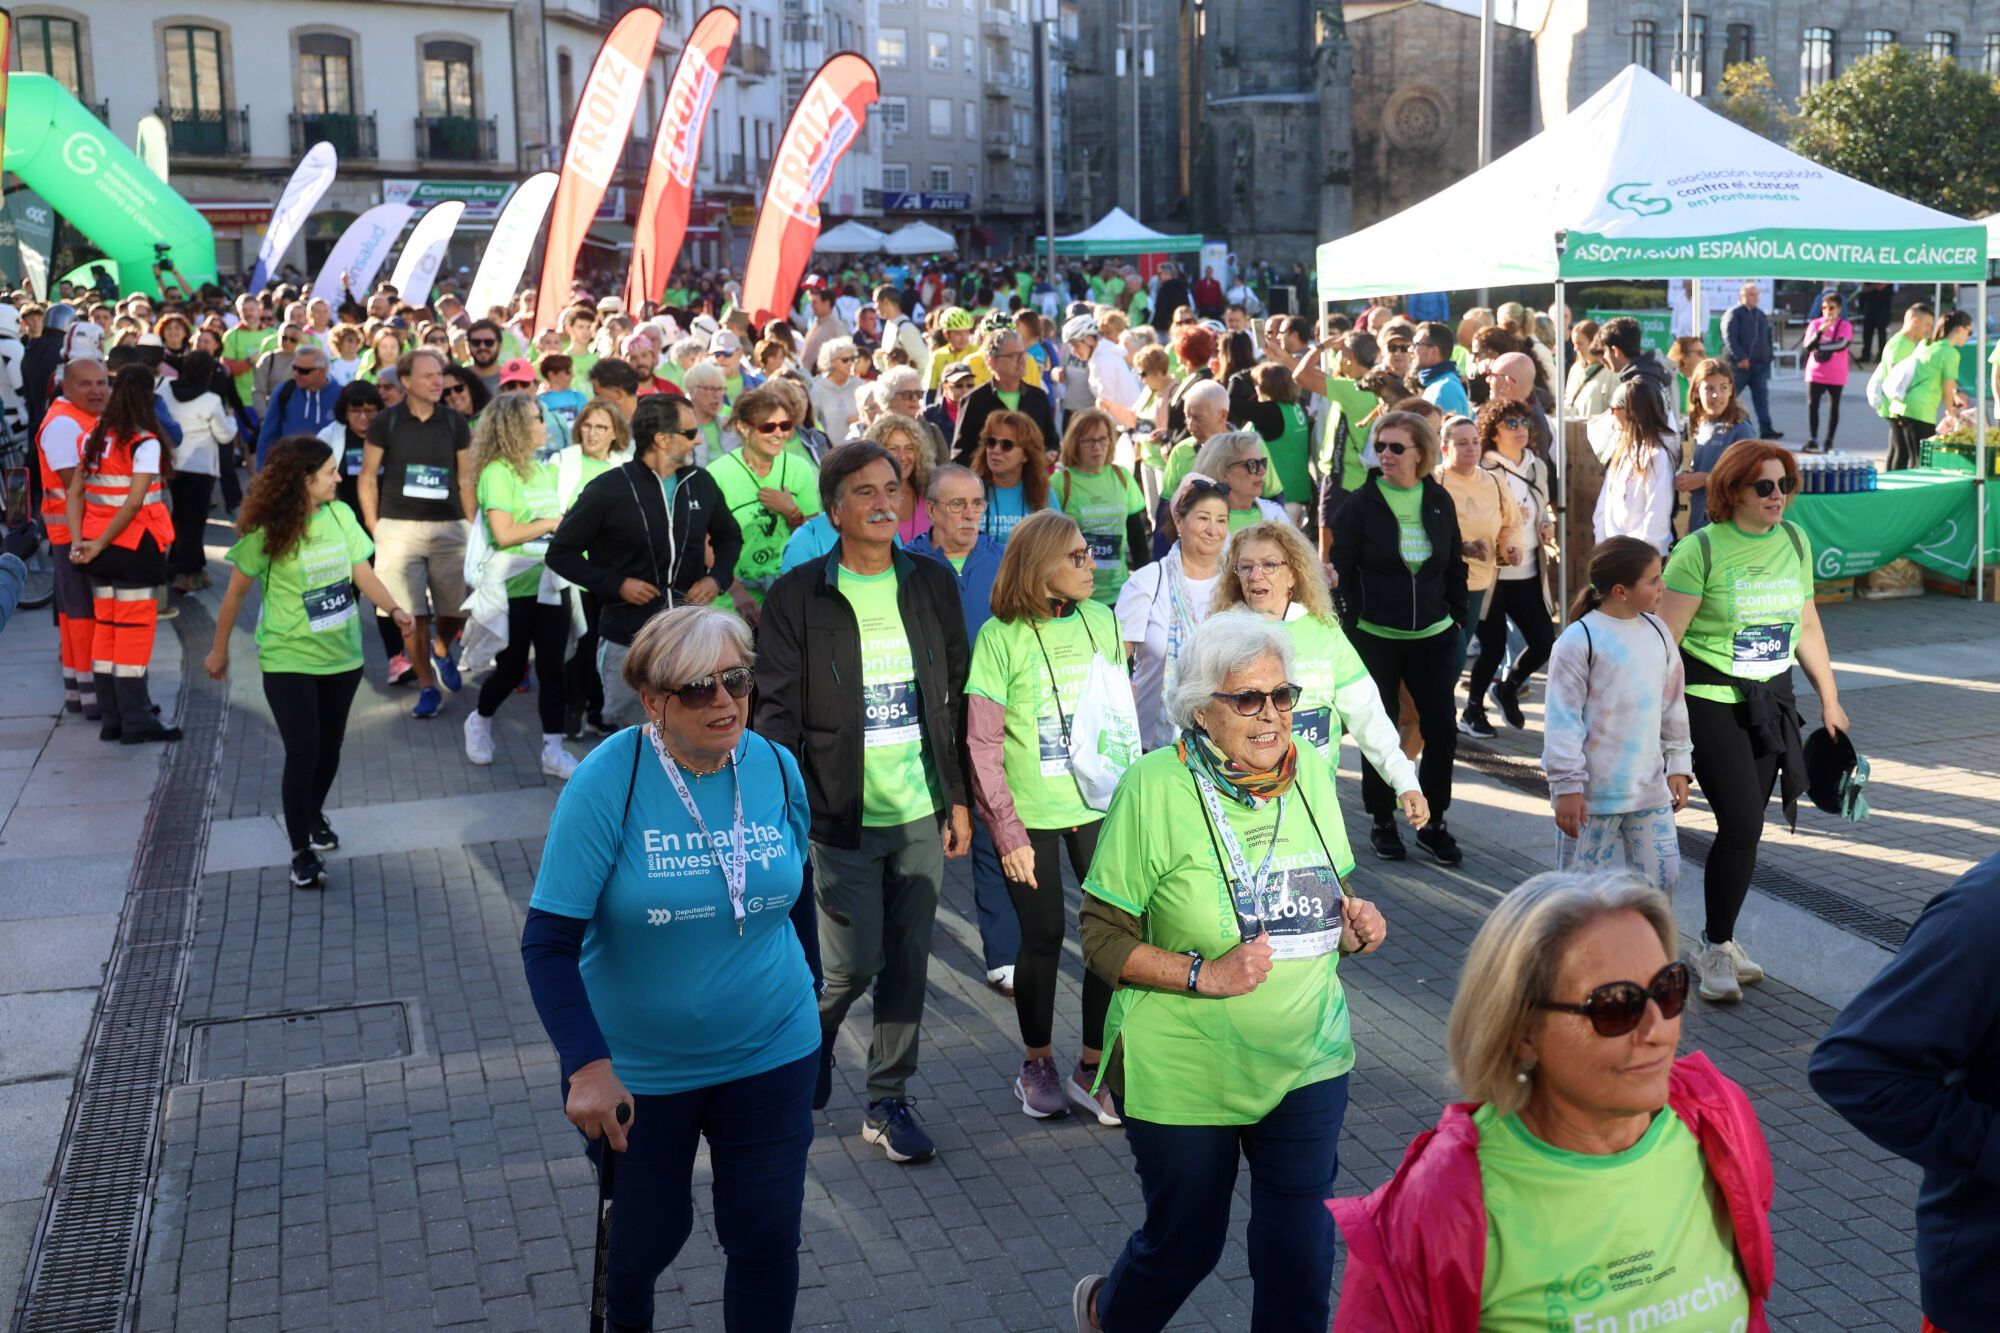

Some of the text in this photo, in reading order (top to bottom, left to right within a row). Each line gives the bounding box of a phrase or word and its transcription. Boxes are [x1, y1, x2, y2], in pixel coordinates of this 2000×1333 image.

[572, 53, 627, 174] FROIZ
[661, 52, 707, 174] FROIZ
[775, 87, 845, 213] FROIZ
[1666, 168, 1823, 187] asociación española
[1676, 180, 1801, 198] contra el cáncer
[1687, 191, 1800, 209] en Pontevedra
[1698, 236, 1795, 260] ESPAÑOLA
[1799, 241, 1876, 264] CONTRA
[1879, 247, 1901, 265] EL
[1904, 243, 1978, 265] CÁNCER
[1094, 544, 1113, 556] 336
[1735, 578, 1799, 590] En marcha
[321, 594, 347, 611] 1341
[1736, 593, 1802, 606] contra o
[1751, 639, 1782, 656] 1960
[862, 653, 913, 672] ontra
[866, 702, 909, 721] 0951
[1243, 822, 1275, 836] asociación
[1245, 831, 1273, 842] española
[643, 829, 680, 852] En
[1248, 840, 1267, 848] contra
[683, 868, 710, 876] cancro
[675, 905, 716, 916] Deputación
[675, 912, 716, 921] Pontevedra
[1269, 895, 1324, 921] 1083
[1606, 1250, 1656, 1269] asociación
[1608, 1263, 1653, 1281] española
[1612, 1266, 1677, 1292] contra o cancro
[1573, 1312, 1619, 1333] En
